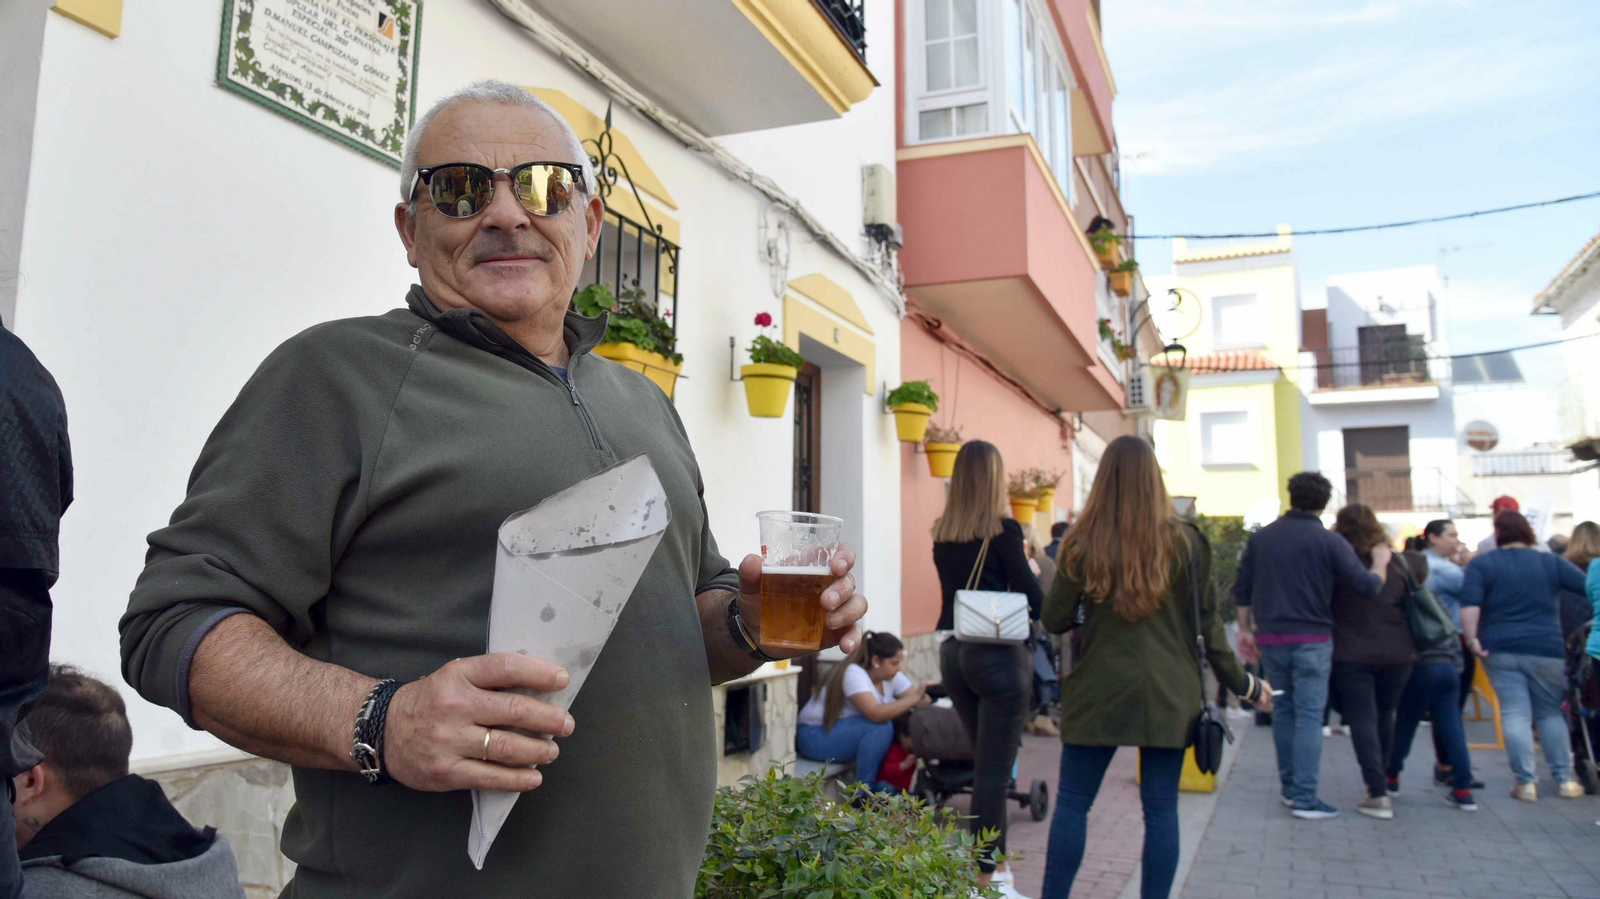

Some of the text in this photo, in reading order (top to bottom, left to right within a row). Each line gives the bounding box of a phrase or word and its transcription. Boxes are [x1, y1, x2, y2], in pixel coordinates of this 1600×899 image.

[286, 0, 381, 57] OPULAR DEL CARNAVAL
[292, 9, 329, 37] ESPECIAL
[321, 5, 337, 19] VIVE
[341, 19, 351, 29] EL
[354, 26, 396, 54] PERSONAJE
[310, 34, 359, 66] CAMPUZANO
